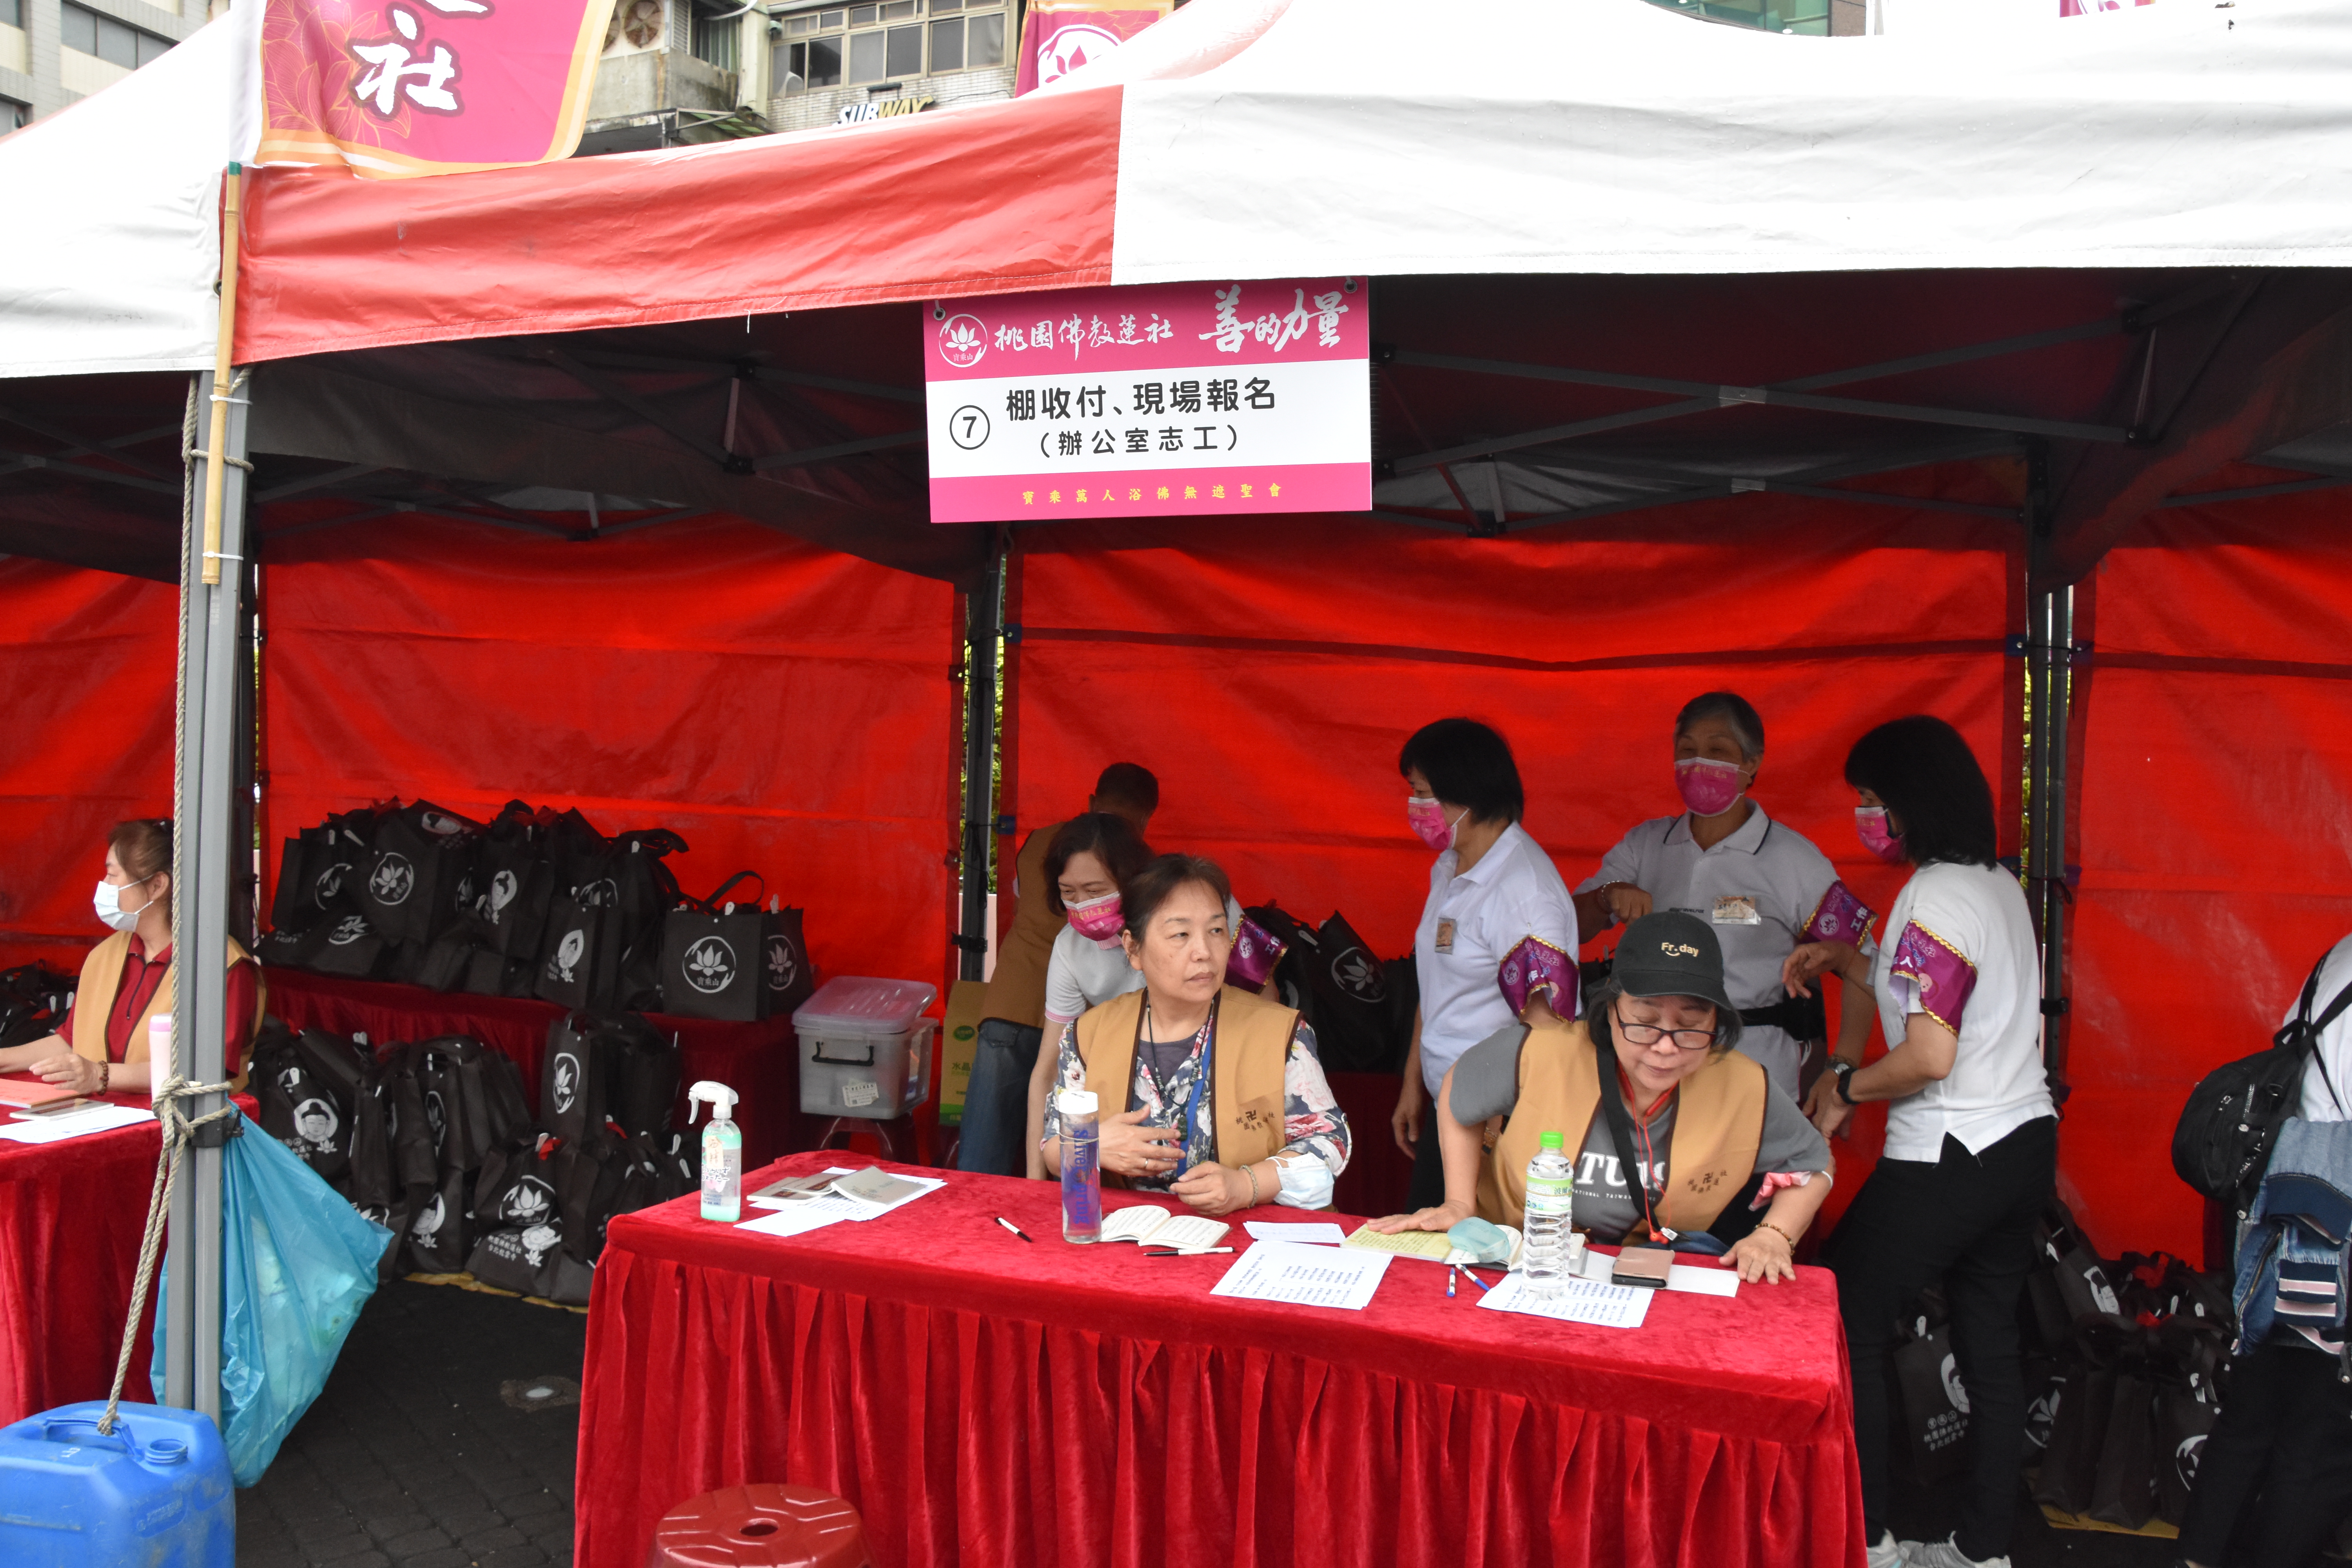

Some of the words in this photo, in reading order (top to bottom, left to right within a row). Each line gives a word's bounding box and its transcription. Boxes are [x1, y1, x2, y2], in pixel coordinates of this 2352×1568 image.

[353, 0, 487, 114] 社
[833, 95, 933, 125] SUBWAY
[994, 313, 1174, 361] 桃園佛教蓮社
[1198, 284, 1349, 353] 善的力量
[1006, 377, 1276, 422] 棚收付、現場報名
[1022, 483, 1281, 505] 寶乘萬人浴佛無遮聖會
